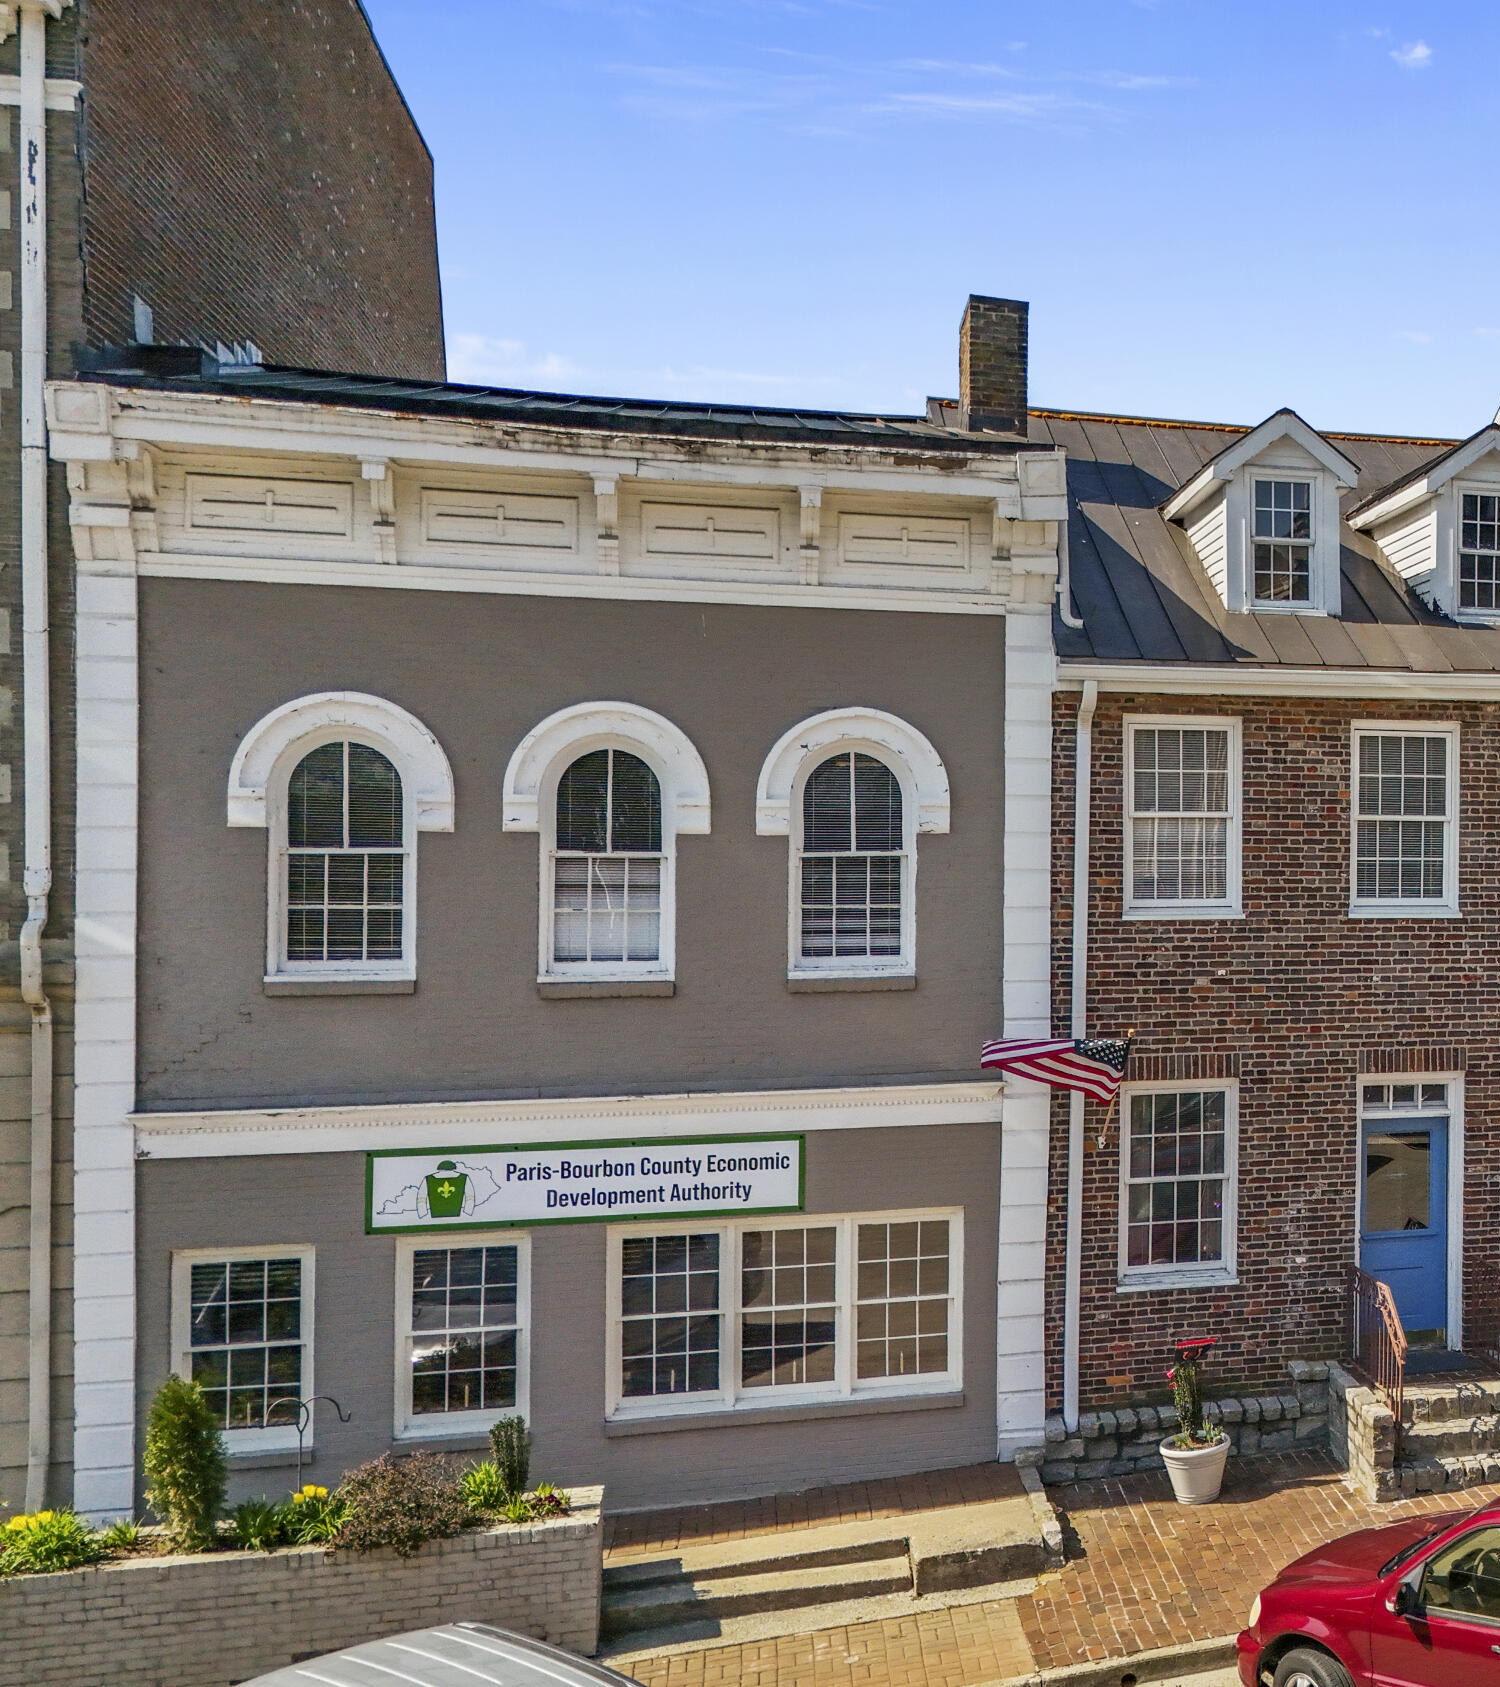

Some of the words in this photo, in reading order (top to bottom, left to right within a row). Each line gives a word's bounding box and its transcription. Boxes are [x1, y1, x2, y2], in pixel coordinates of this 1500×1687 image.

[505, 1158, 635, 1182] Paris-Bourbon
[640, 1156, 703, 1178] County
[706, 1151, 791, 1173] Economic
[546, 1185, 666, 1209] Development
[669, 1181, 753, 1203] Authority
